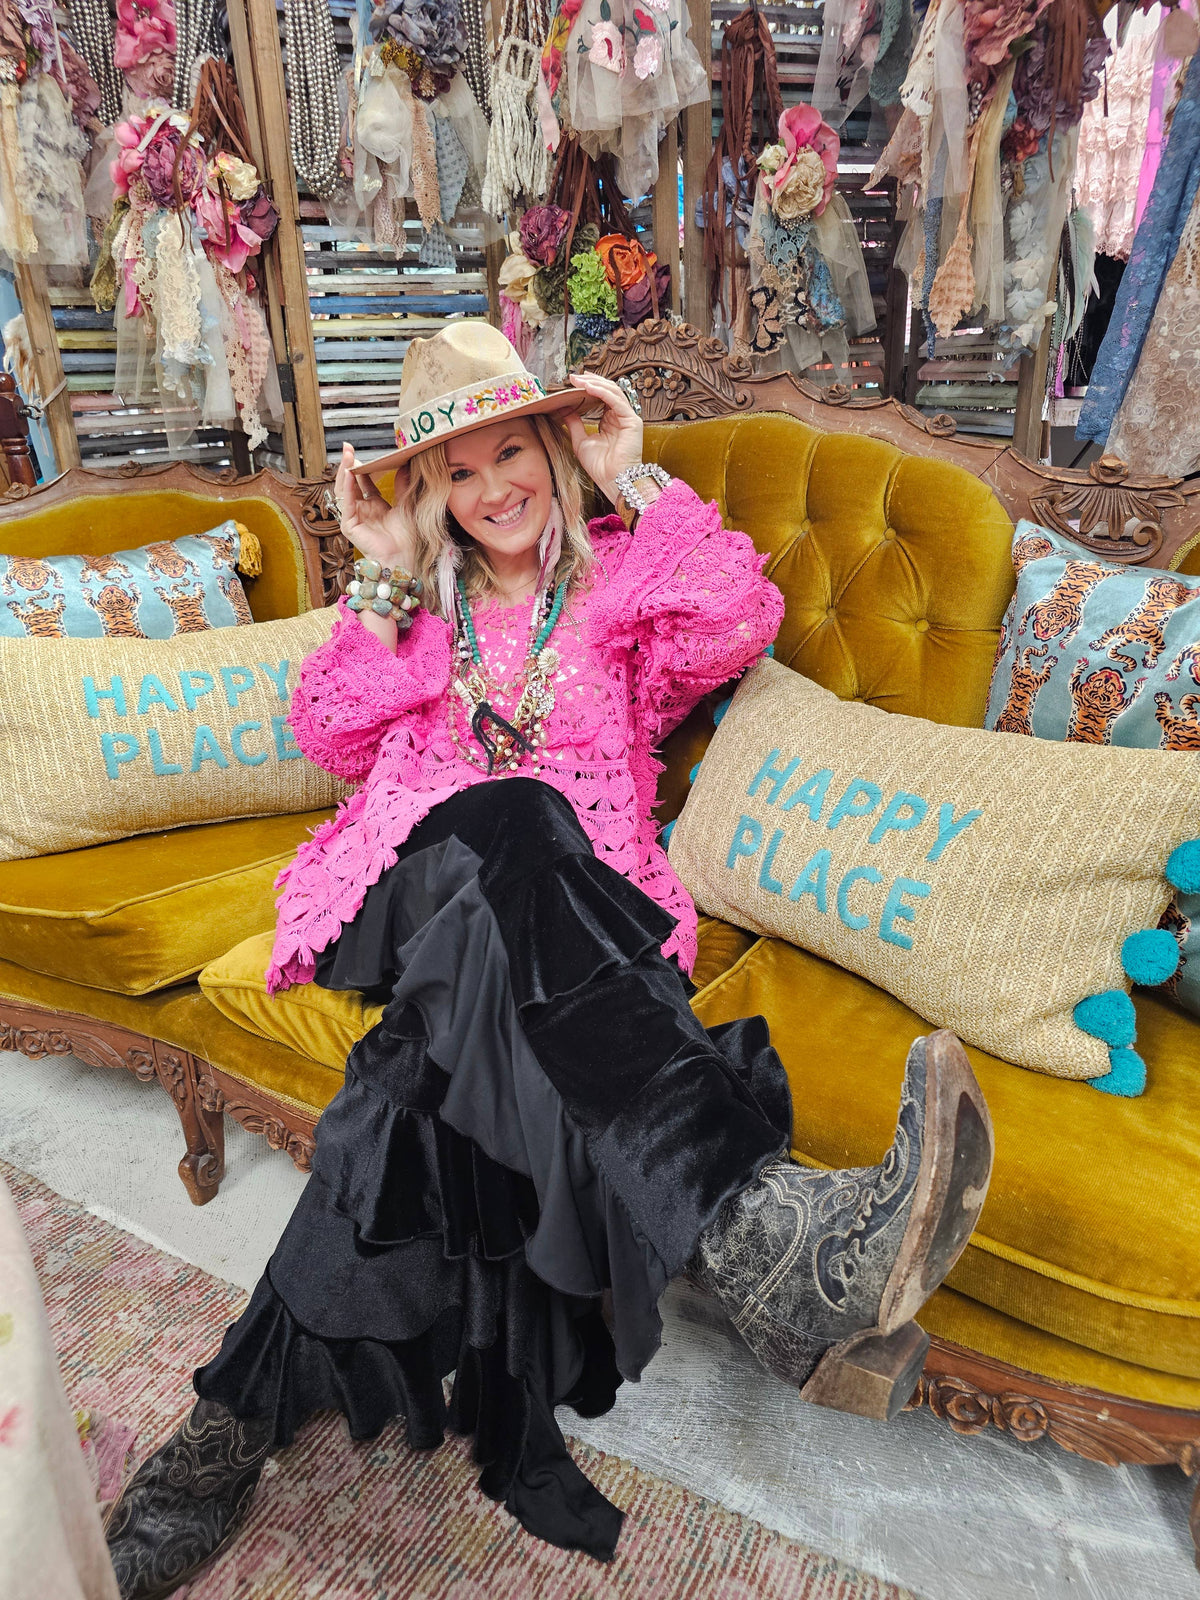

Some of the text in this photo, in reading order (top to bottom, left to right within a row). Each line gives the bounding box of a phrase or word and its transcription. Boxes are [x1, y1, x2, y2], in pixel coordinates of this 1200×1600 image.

[410, 401, 454, 443] JOY
[82, 660, 289, 718] HAPPY
[101, 716, 304, 780] PLACE
[746, 747, 983, 862] HAPPY
[726, 814, 932, 950] PLACE
